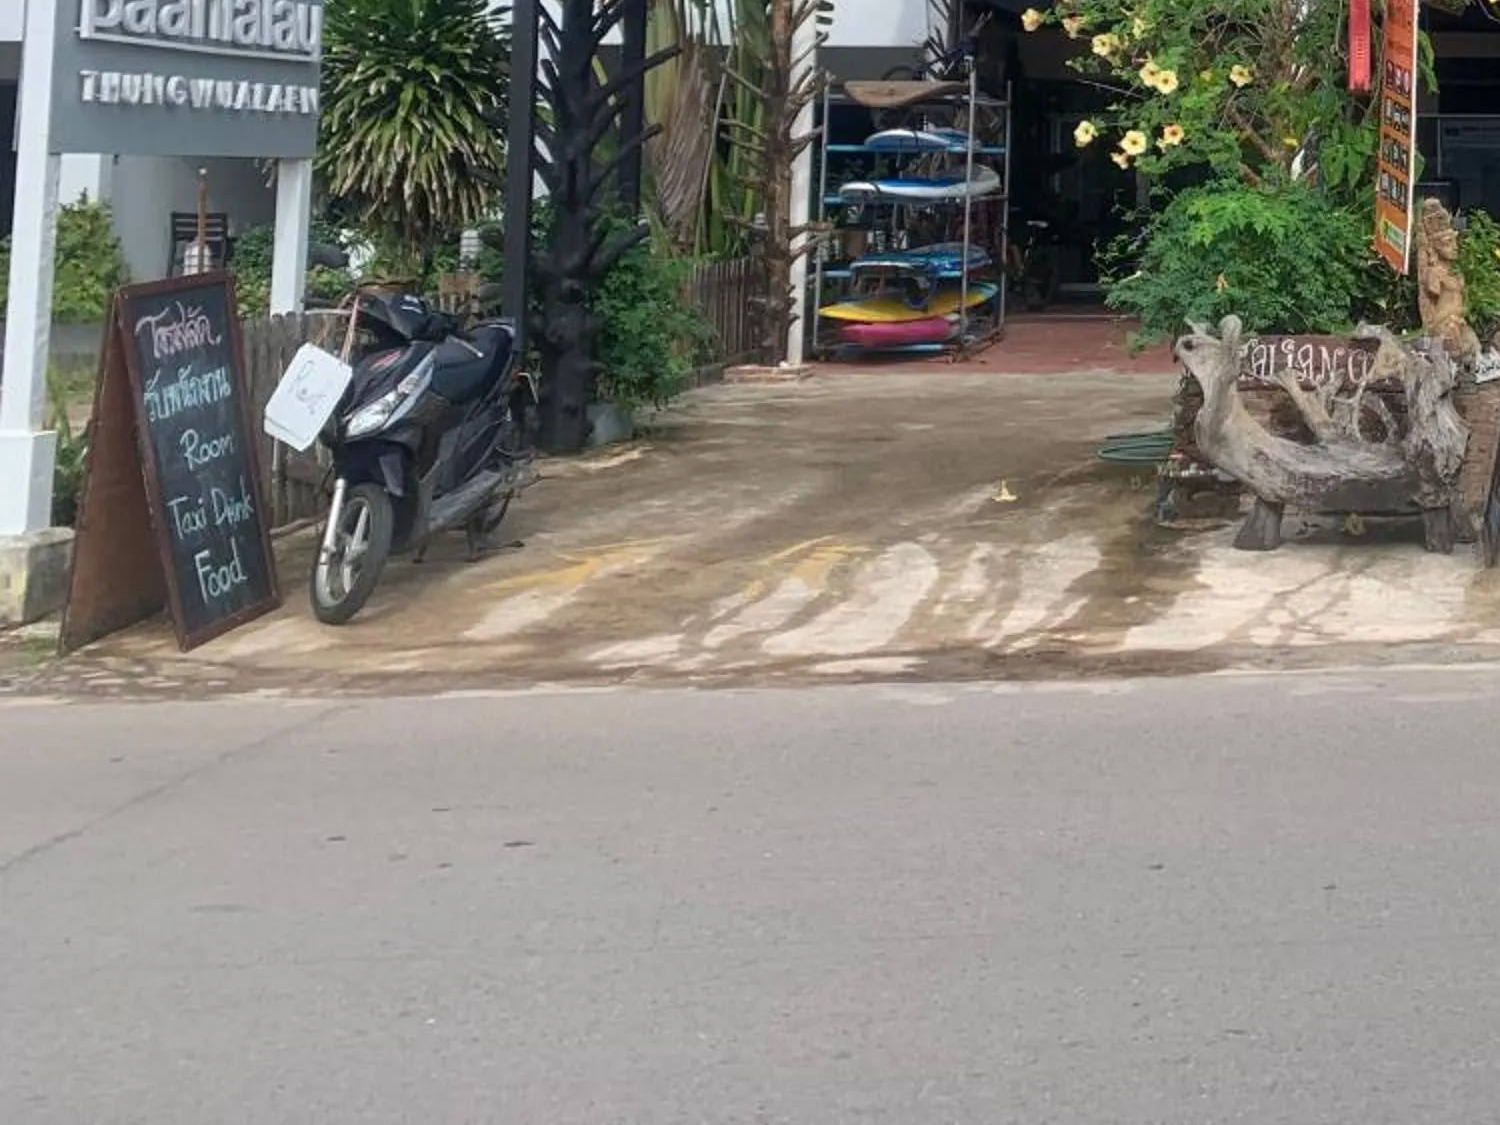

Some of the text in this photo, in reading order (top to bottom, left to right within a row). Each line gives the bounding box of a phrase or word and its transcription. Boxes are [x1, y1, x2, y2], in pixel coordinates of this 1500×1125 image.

[179, 427, 235, 471] Room
[167, 477, 253, 541] Taxi Drink
[194, 537, 248, 604] Food
